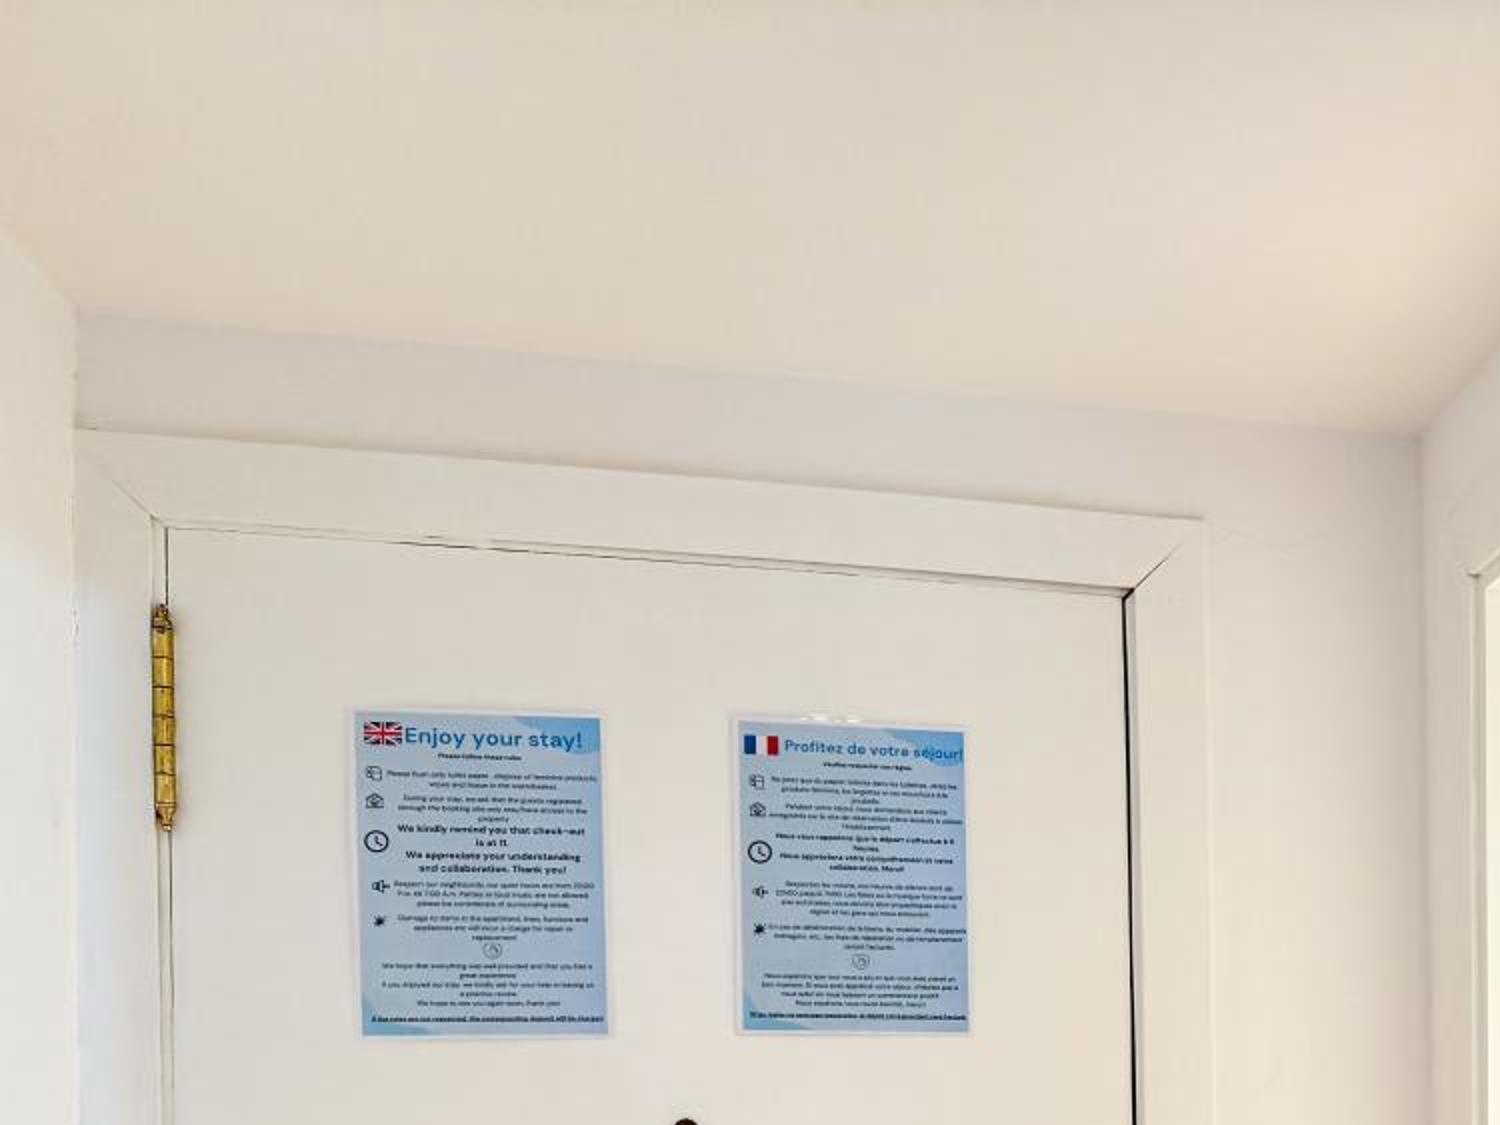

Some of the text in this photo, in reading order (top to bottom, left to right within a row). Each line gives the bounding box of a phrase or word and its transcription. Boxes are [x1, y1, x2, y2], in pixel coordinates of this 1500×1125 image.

[405, 727, 582, 752] Enjoy your stay!
[785, 738, 963, 763] Profitez de votre séjour!
